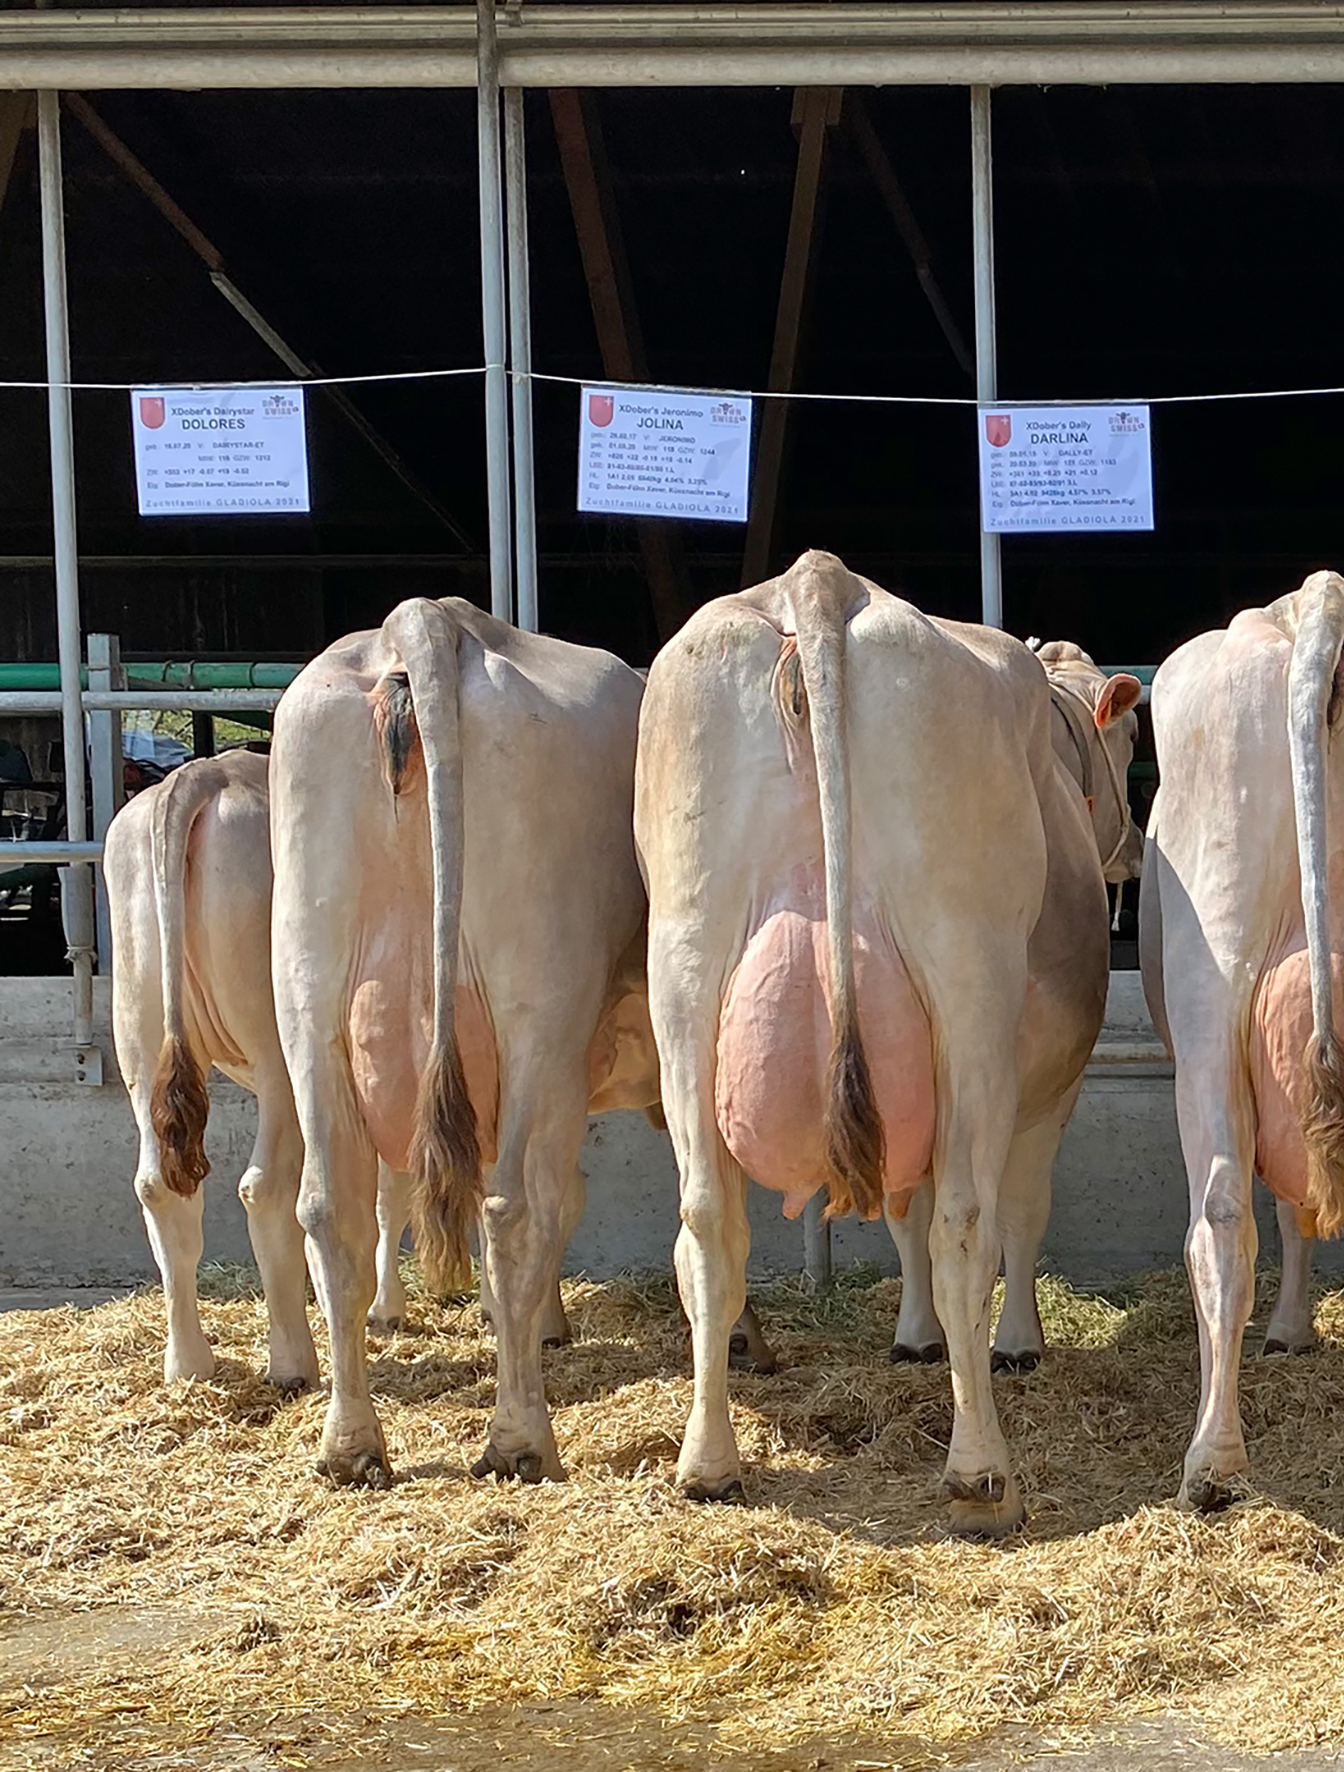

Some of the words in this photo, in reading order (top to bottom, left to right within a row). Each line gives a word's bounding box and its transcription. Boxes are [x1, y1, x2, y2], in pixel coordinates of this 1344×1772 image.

[171, 407, 211, 416] XDober's
[214, 407, 255, 416] Dairystar
[619, 404, 659, 414] XDober's
[663, 407, 703, 417] Jeronimo
[182, 419, 245, 430] DOLORES
[637, 418, 684, 430] JOLINA
[1026, 421, 1066, 430] XDober's
[1069, 421, 1091, 430] Dally
[659, 435, 696, 443] JERONIMO
[1031, 433, 1088, 444] DARLINA
[146, 500, 211, 508] Zuchtfamilie
[216, 498, 271, 507] GLADIOLA
[276, 498, 299, 506] 2021
[586, 498, 651, 508] Zuchtfamilie
[656, 500, 710, 512] GLADIOLA
[715, 505, 739, 514] 2021
[991, 518, 1056, 526] Zuchtfamilie
[1062, 516, 1116, 524] GLADIOLA
